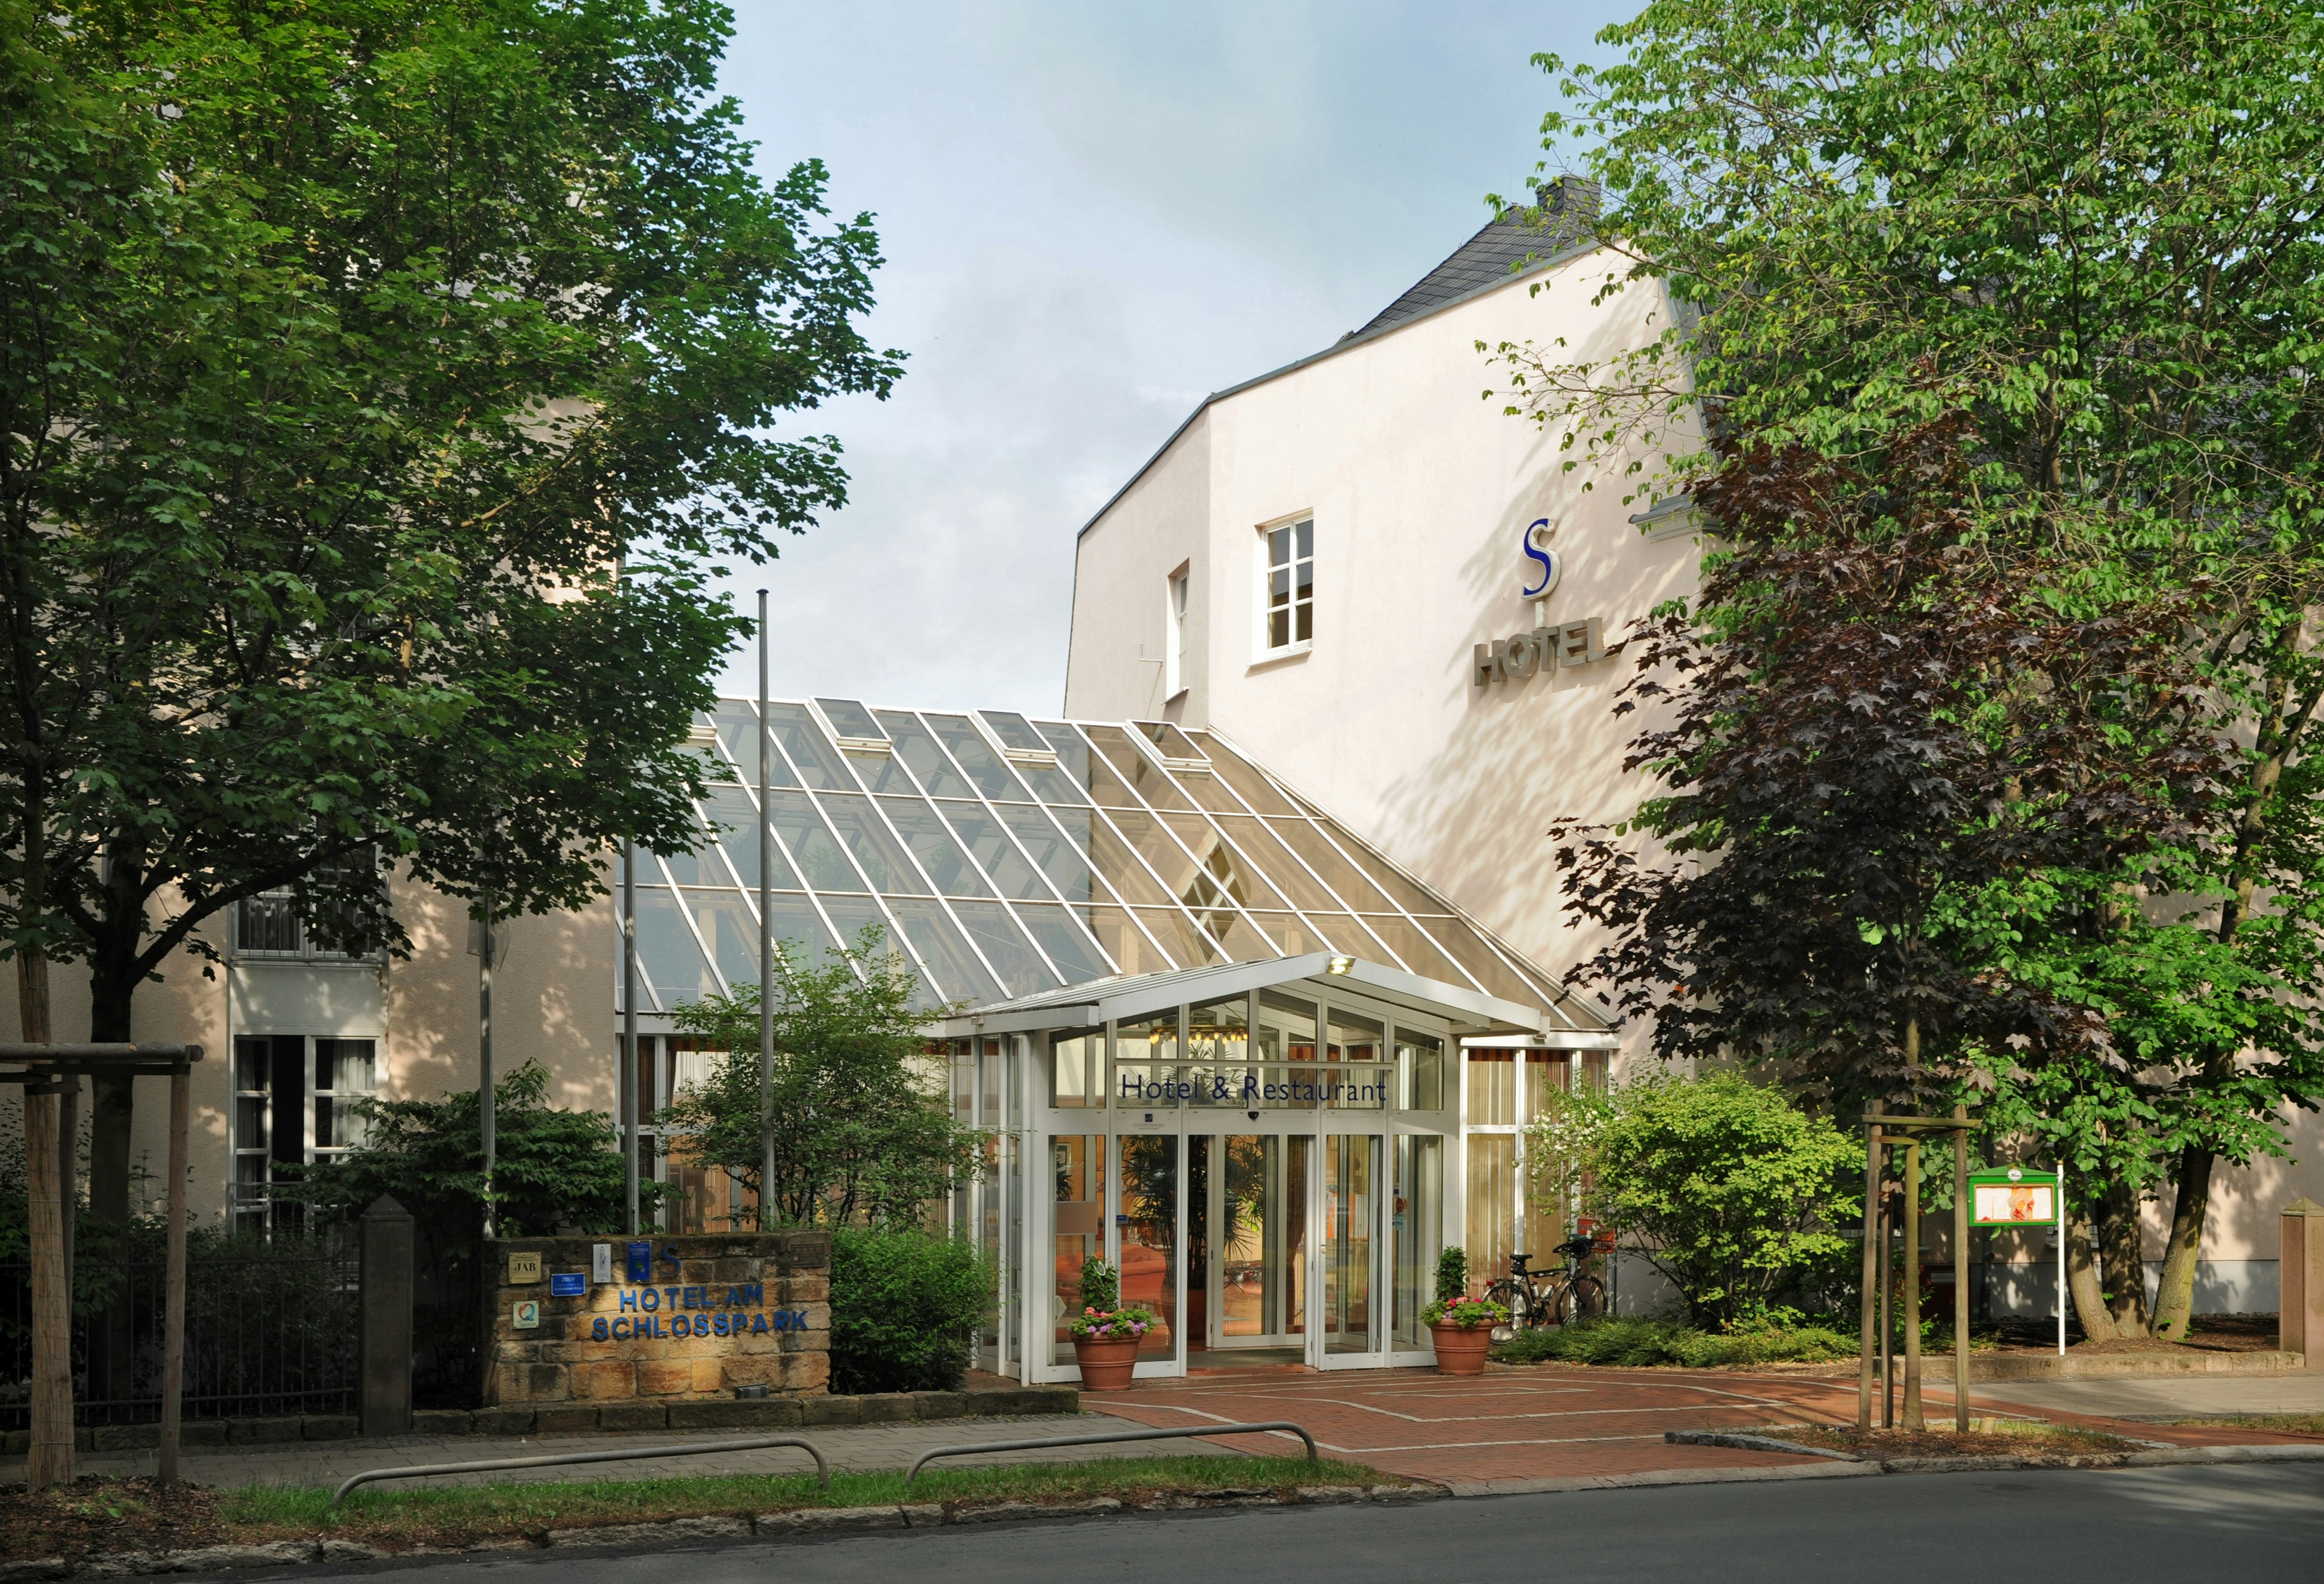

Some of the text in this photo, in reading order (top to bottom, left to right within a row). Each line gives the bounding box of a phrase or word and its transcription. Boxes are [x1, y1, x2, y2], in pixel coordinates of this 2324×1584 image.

[1523, 518, 1559, 599] S
[1474, 617, 1612, 686] HOTEL
[1122, 1074, 1386, 1101] Hotel & Restaurant
[514, 1262, 536, 1271] JAB
[619, 1283, 764, 1311] HOTEL AM
[591, 1310, 808, 1339] SCHLOSSPARK
